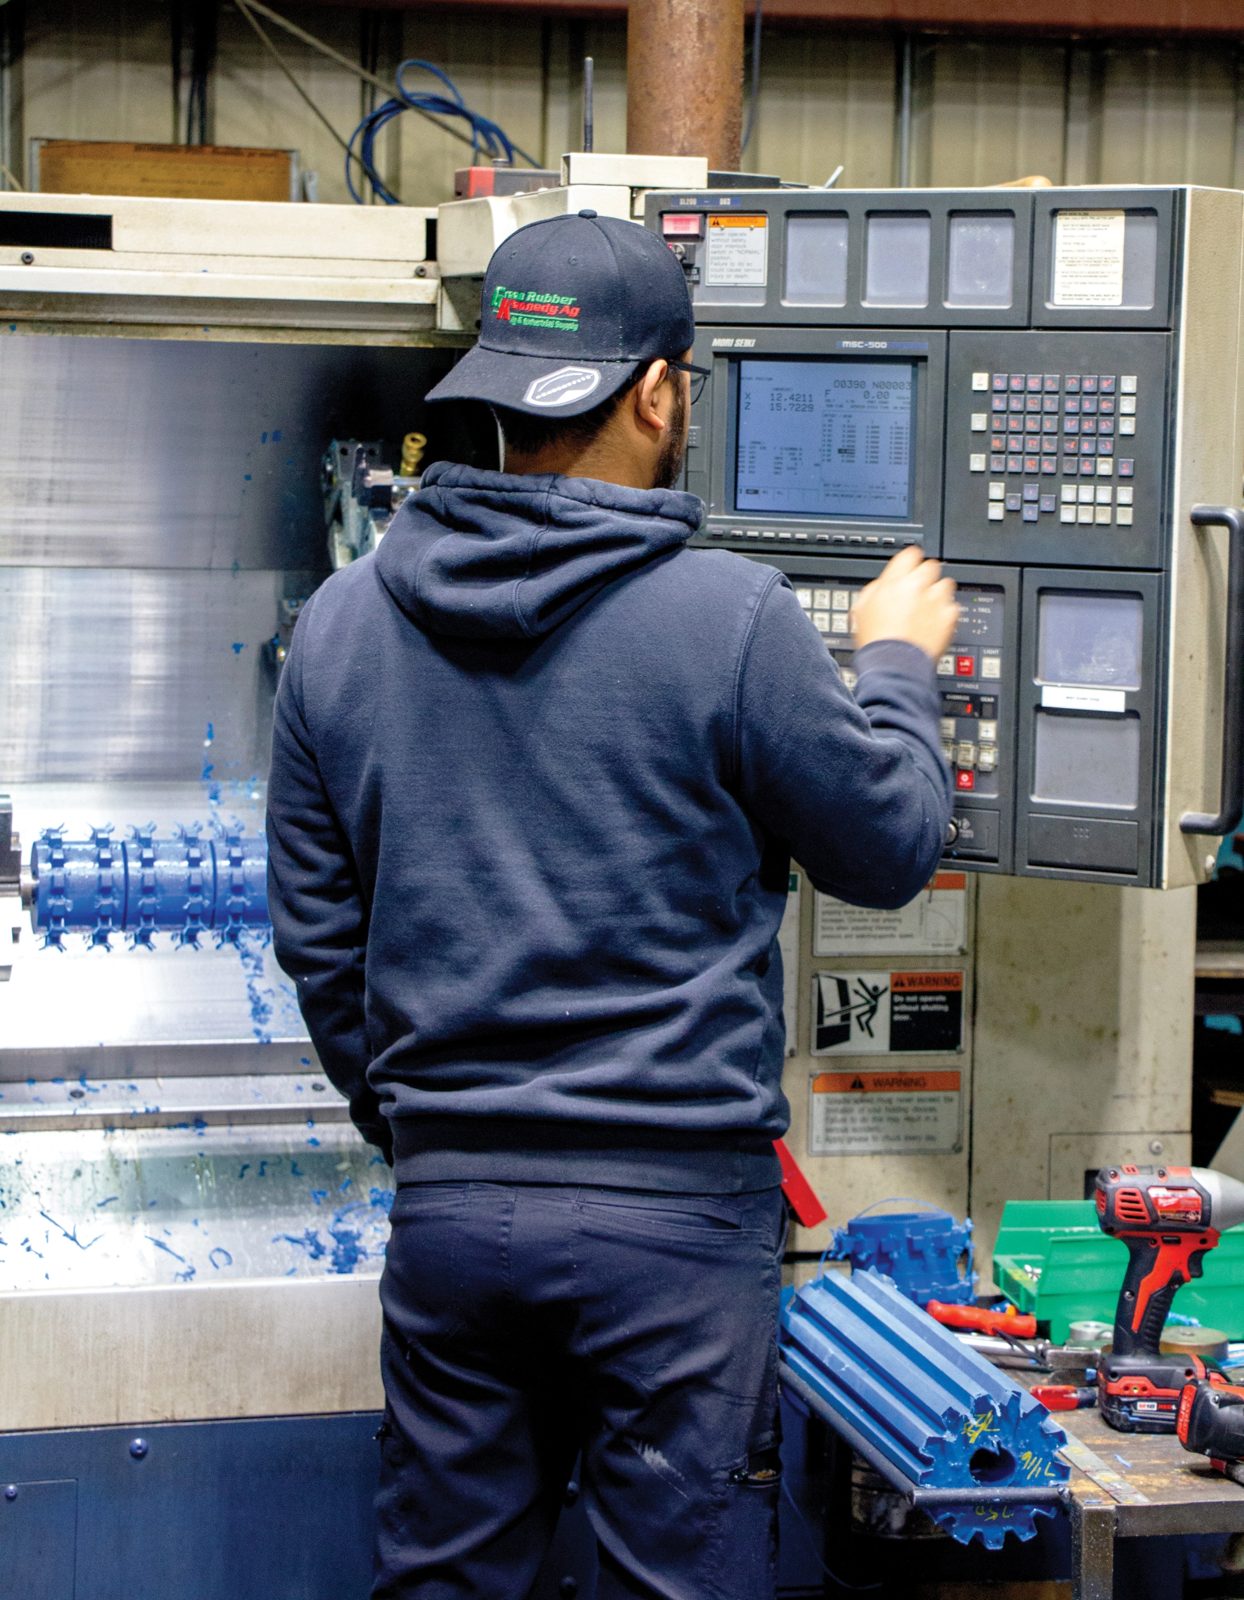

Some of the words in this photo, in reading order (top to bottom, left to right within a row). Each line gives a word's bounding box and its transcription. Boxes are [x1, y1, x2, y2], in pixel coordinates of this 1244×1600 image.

[526, 291, 577, 305] Rubber
[559, 305, 580, 317] Ag
[745, 392, 752, 400] X
[770, 392, 813, 403] 12.4211
[863, 391, 890, 399] 0.00
[744, 402, 752, 411] Z
[770, 402, 815, 412] 15.7229
[908, 976, 962, 987] WARNING
[919, 995, 947, 1003] operate
[873, 1077, 926, 1088] WARNING
